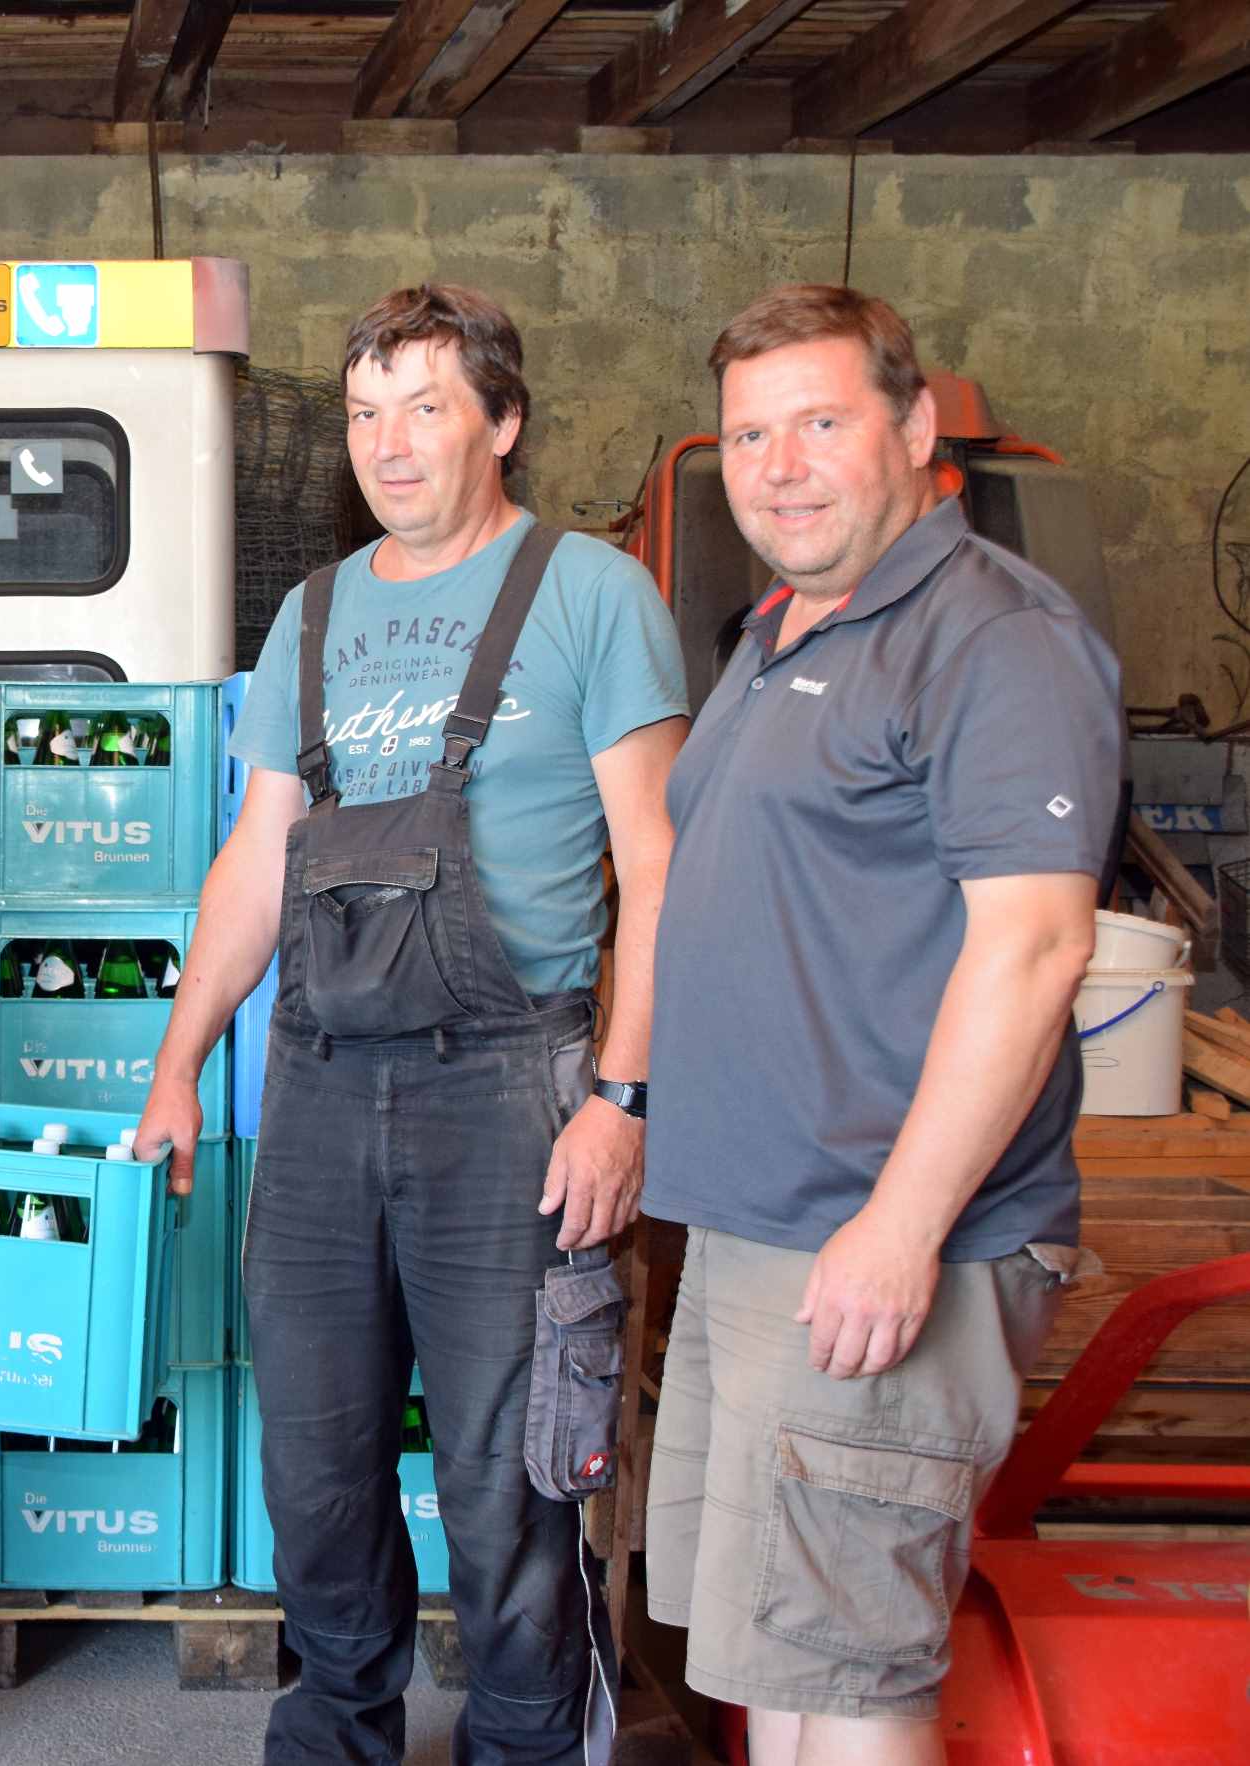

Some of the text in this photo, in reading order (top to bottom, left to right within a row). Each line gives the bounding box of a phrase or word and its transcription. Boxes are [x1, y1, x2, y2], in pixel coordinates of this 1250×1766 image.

[362, 654, 442, 673] ORIGINAL
[349, 667, 454, 688] DENIMWEAR
[408, 736, 432, 748] 1982
[21, 820, 151, 845] VITUS
[93, 851, 150, 863] Brunnen
[24, 1491, 47, 1505] Die
[21, 1509, 159, 1535] VITUS
